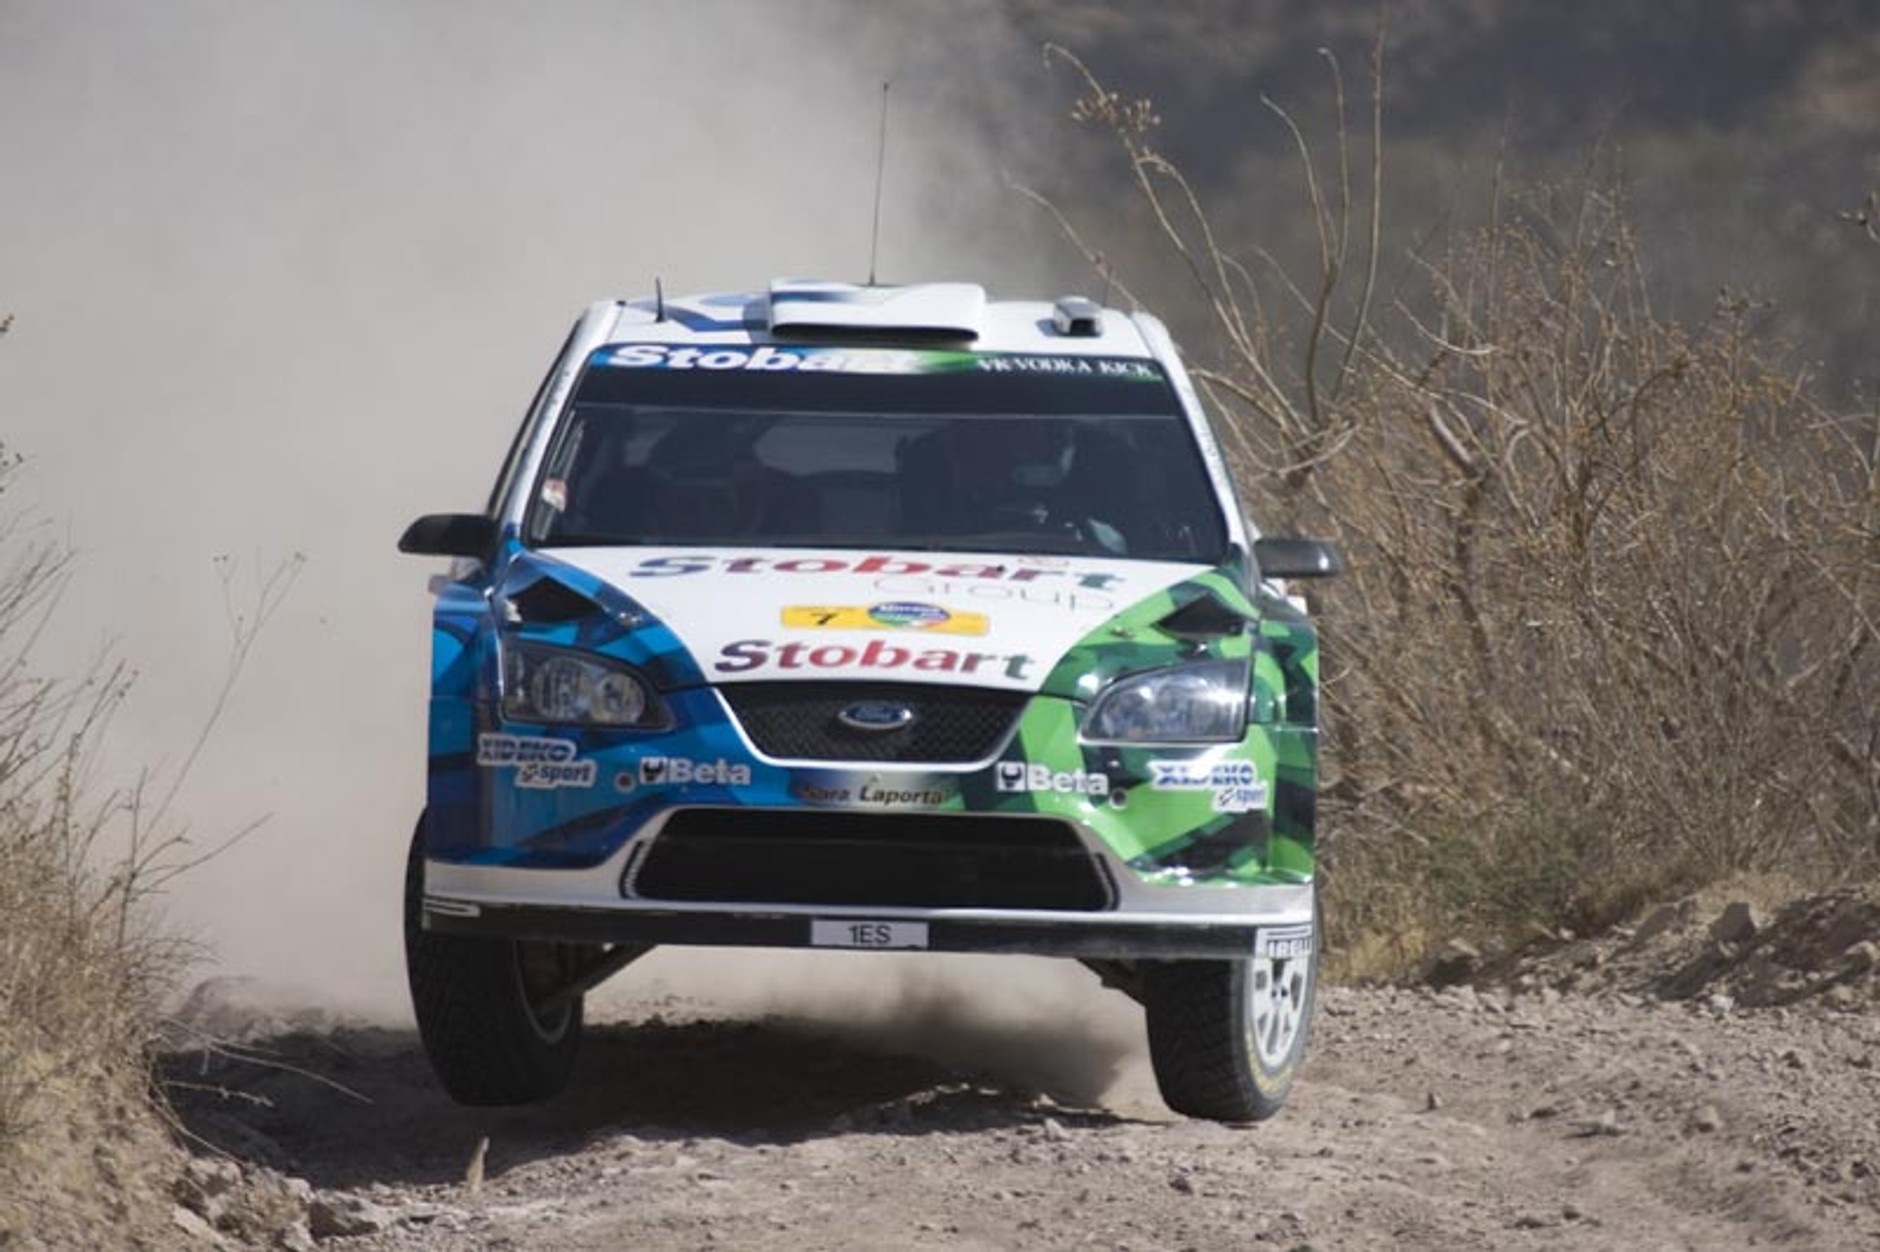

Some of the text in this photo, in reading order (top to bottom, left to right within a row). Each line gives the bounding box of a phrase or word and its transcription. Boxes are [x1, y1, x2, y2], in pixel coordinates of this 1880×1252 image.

[1013, 357, 1092, 374] VODKA
[1099, 361, 1153, 377] KICK
[629, 556, 1125, 591] Stobart
[714, 639, 1040, 680] Stobart
[669, 758, 750, 785] Beta
[1027, 764, 1109, 795] Beta
[859, 785, 943, 806] Laporta
[848, 924, 892, 944] 1ES
